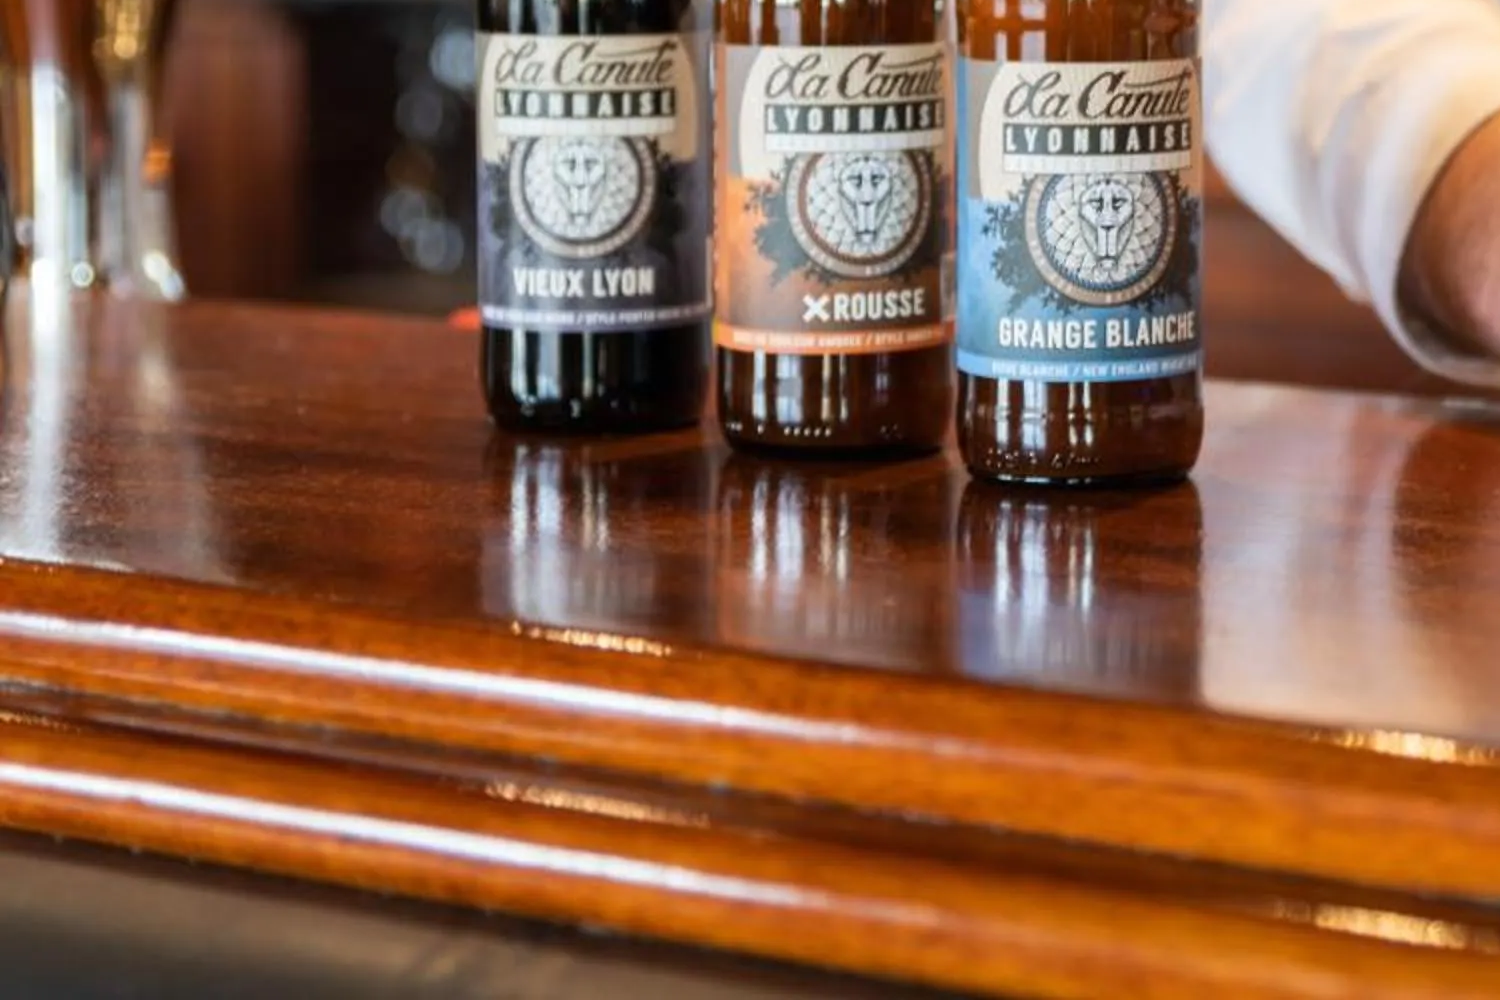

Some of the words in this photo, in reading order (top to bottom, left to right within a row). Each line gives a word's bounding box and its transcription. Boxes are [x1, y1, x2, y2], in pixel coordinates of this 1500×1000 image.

[495, 40, 546, 85] La
[553, 39, 679, 86] Canute
[765, 53, 829, 100] La
[496, 91, 672, 118] LYONNAISE
[1003, 71, 1068, 120] La
[1076, 70, 1192, 120] Canute
[767, 103, 943, 132] LYONNAISE
[1005, 123, 1190, 153] LYONNAISE
[513, 267, 585, 298] VIEUX
[592, 266, 656, 298] LYON
[998, 317, 1098, 350] GRANGE
[1105, 310, 1195, 348] BLANCHE
[1082, 361, 1108, 377] NEW
[1111, 359, 1158, 377] ENGLAND
